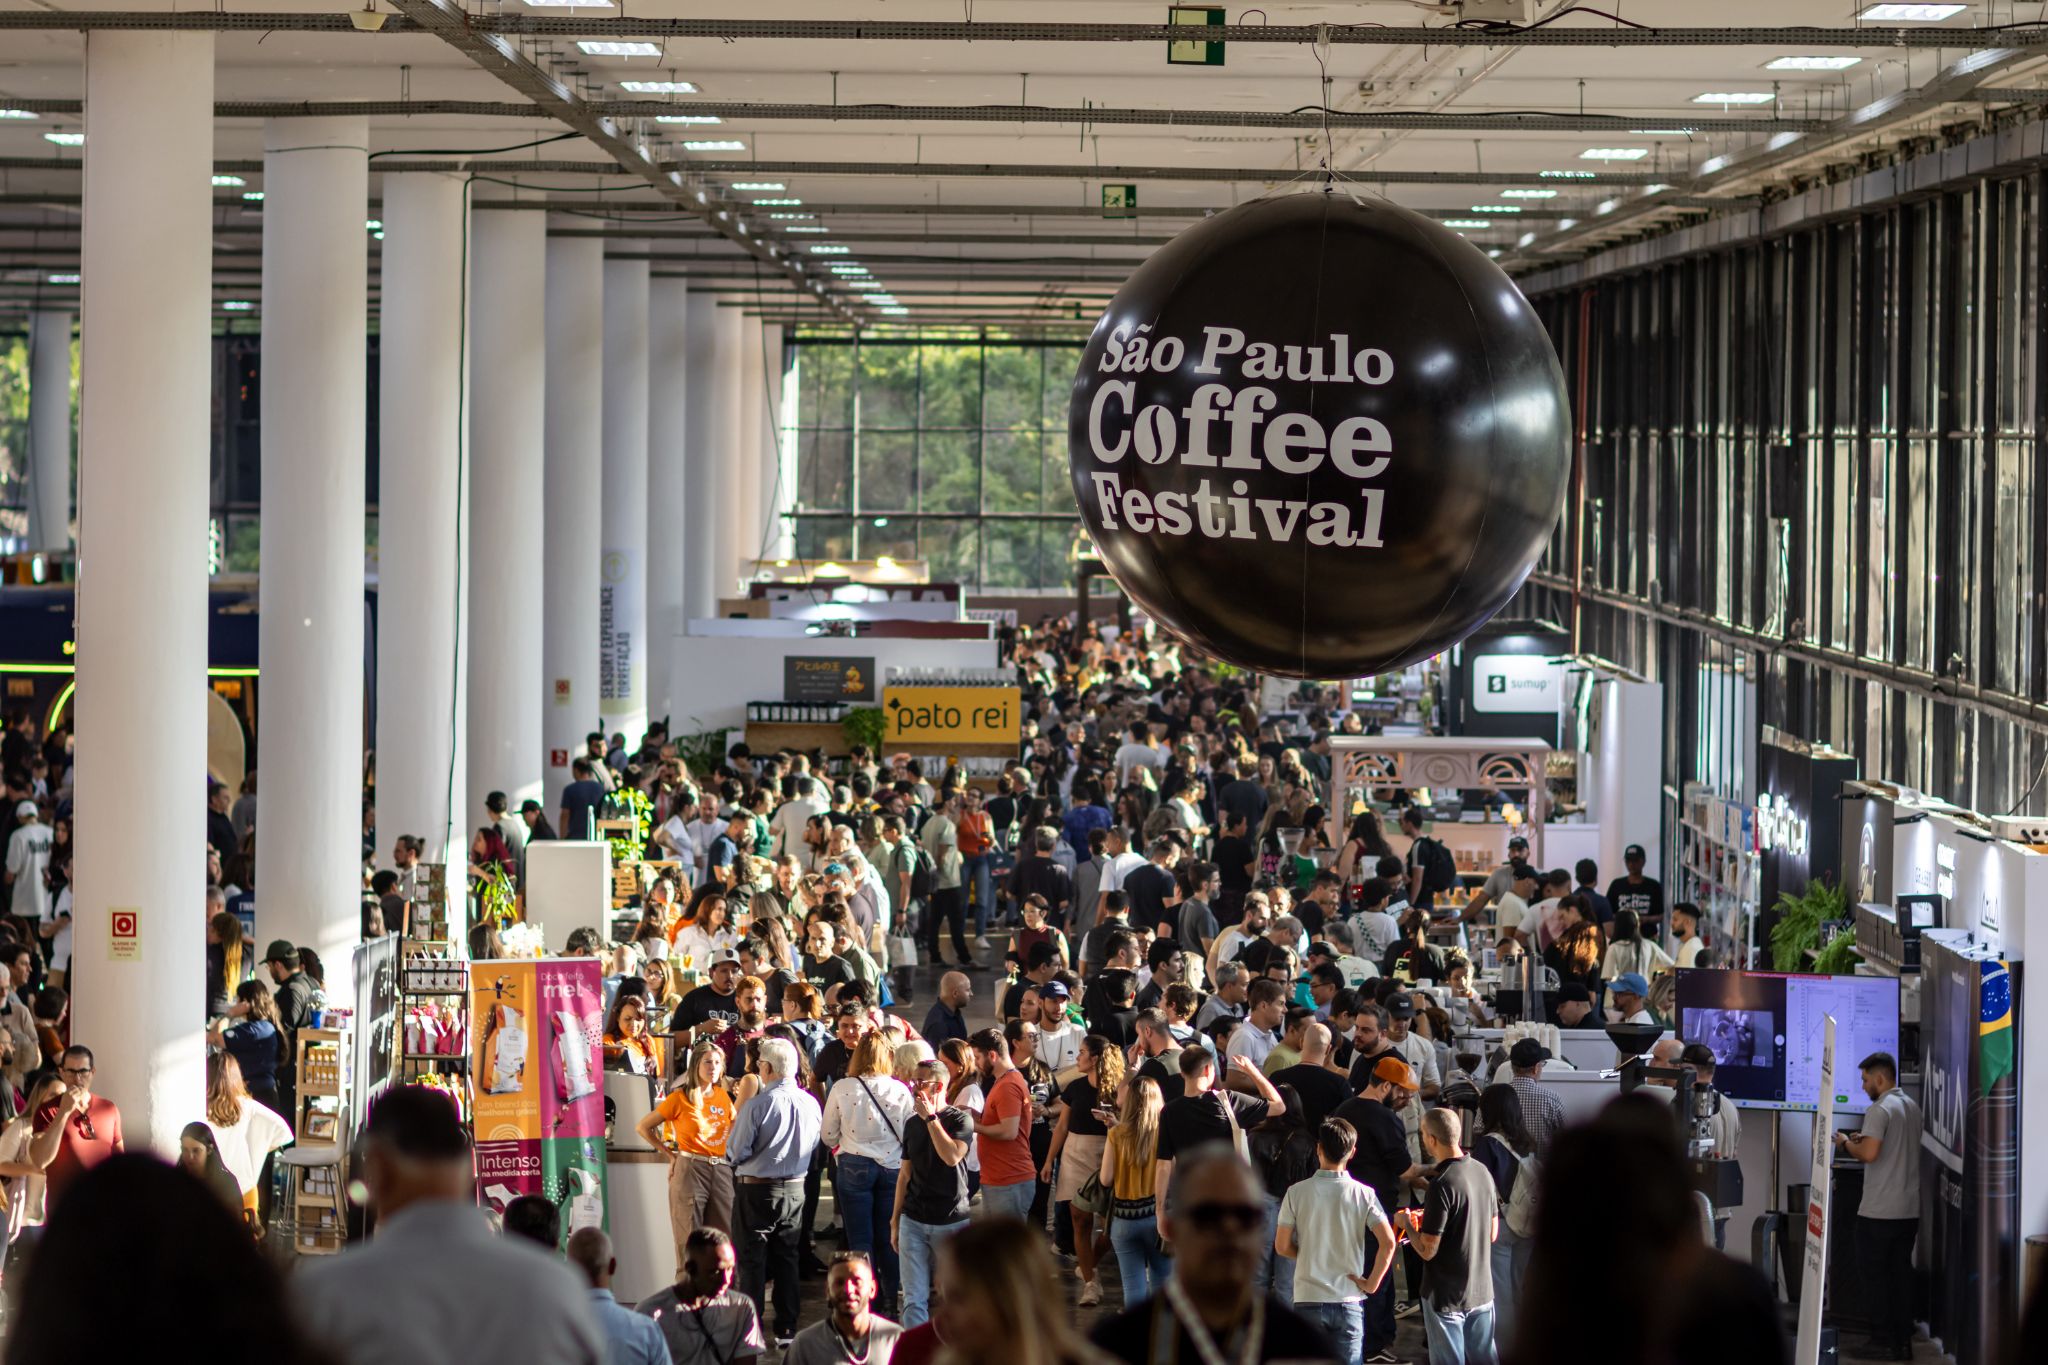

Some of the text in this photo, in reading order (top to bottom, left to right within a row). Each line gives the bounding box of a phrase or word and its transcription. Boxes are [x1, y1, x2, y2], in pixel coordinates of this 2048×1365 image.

[1098, 324, 1394, 385] São Paulo
[1089, 379, 1392, 478] Coffee
[1091, 472, 1385, 547] Festival
[600, 587, 613, 699] SENSORY EXPERIENCE
[616, 632, 631, 698] TORREFAÇÃO
[1511, 679, 1547, 692] sumup
[897, 701, 1007, 735] pato rei
[543, 981, 583, 998] mel
[482, 1155, 540, 1169] Intenso
